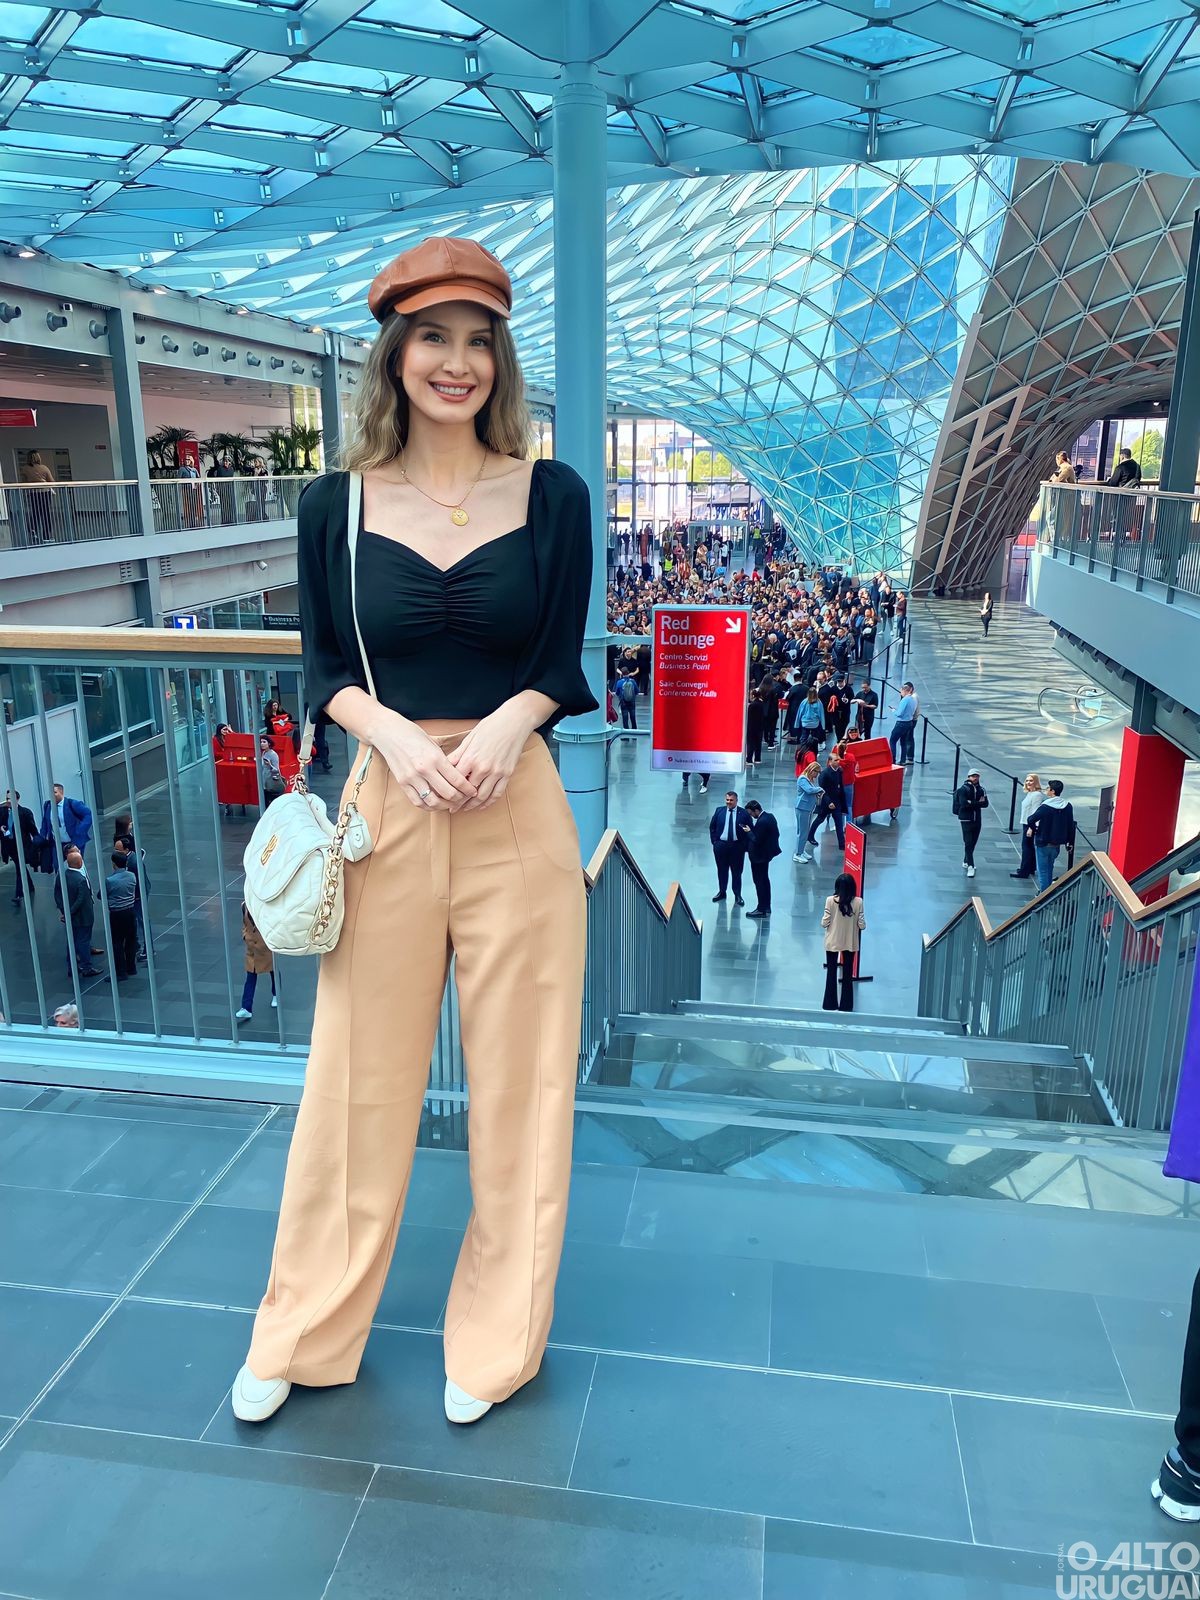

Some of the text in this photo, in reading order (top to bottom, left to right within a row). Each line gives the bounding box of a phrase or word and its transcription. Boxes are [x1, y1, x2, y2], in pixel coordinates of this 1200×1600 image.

[661, 616, 690, 630] Red
[660, 631, 715, 649] Lounge
[659, 653, 708, 661] Centro Servizi
[659, 662, 711, 671] Business Point
[676, 681, 708, 690] Convegni
[659, 689, 717, 698] Conference Halls
